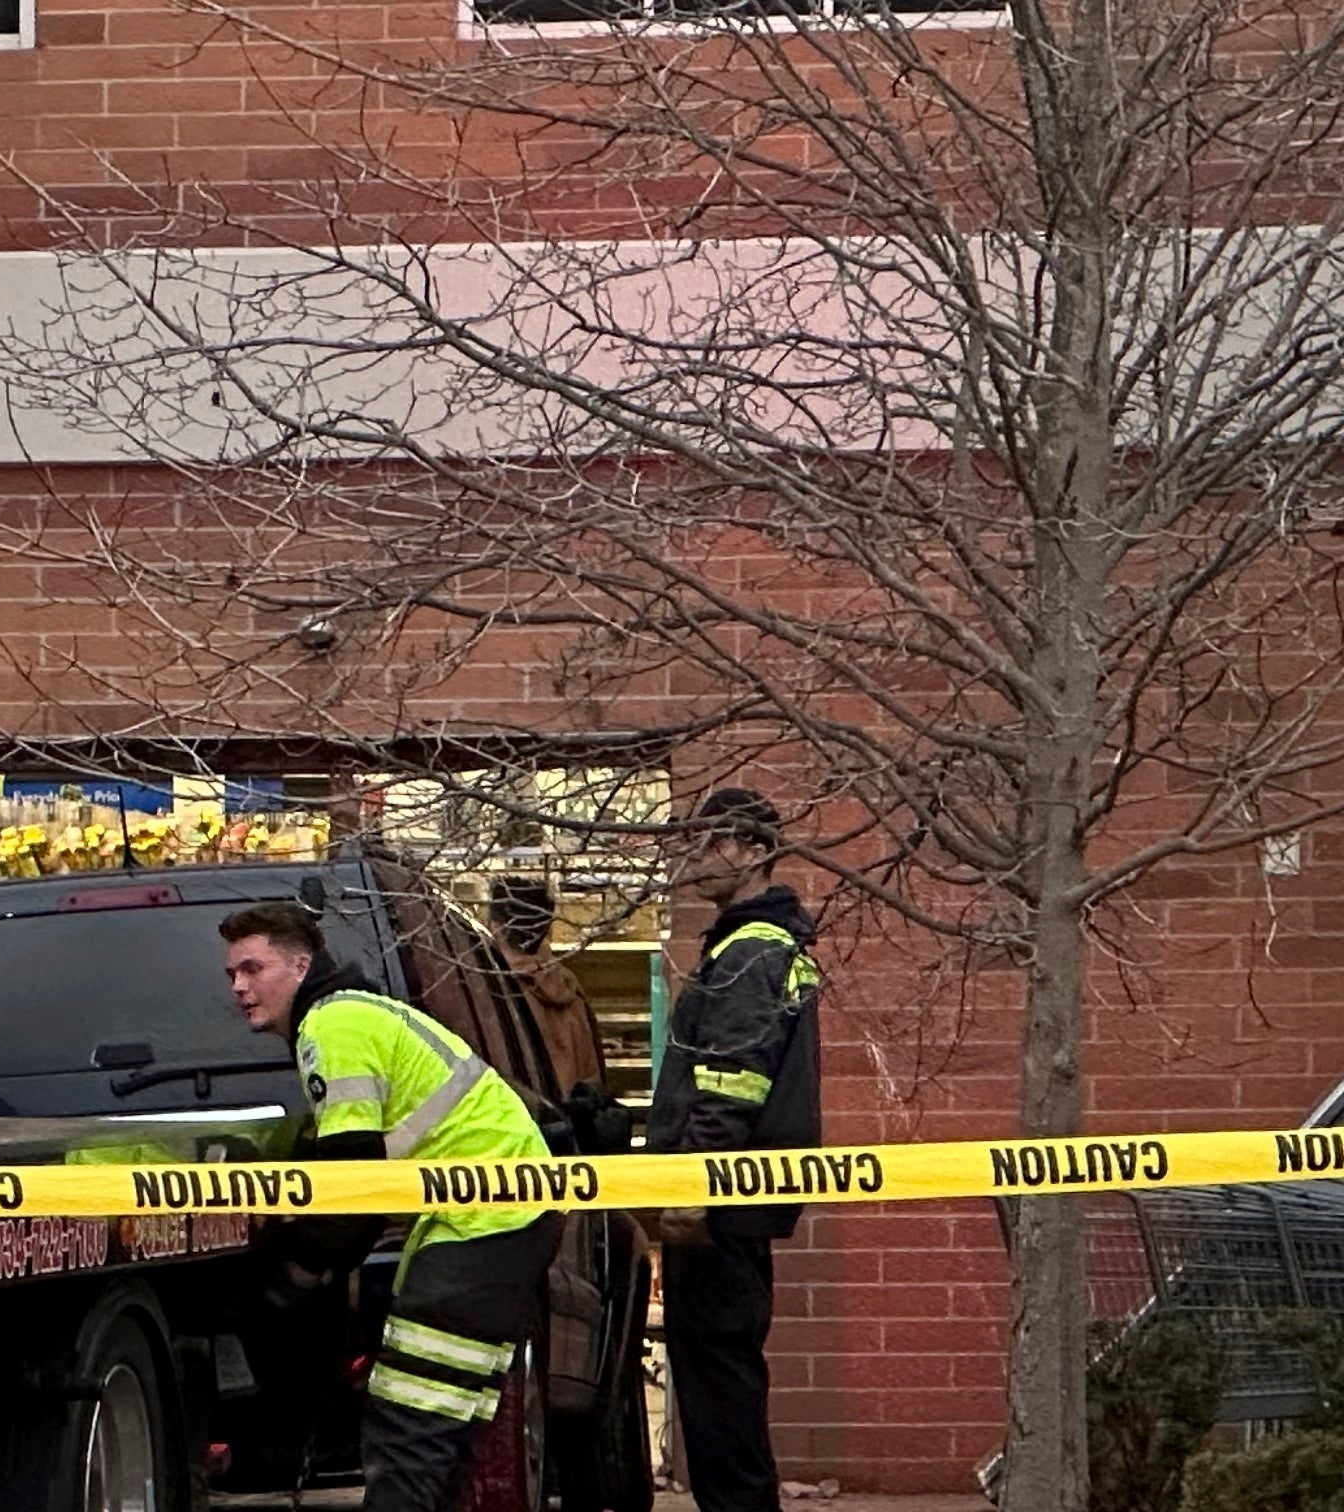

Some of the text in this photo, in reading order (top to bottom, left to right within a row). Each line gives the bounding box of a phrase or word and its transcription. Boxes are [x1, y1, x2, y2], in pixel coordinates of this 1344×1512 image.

[132, 1169, 313, 1208] CAUTION
[419, 1162, 598, 1203] CAUTION
[705, 1153, 883, 1196] CAUTION
[989, 1141, 1169, 1187] CAUTION
